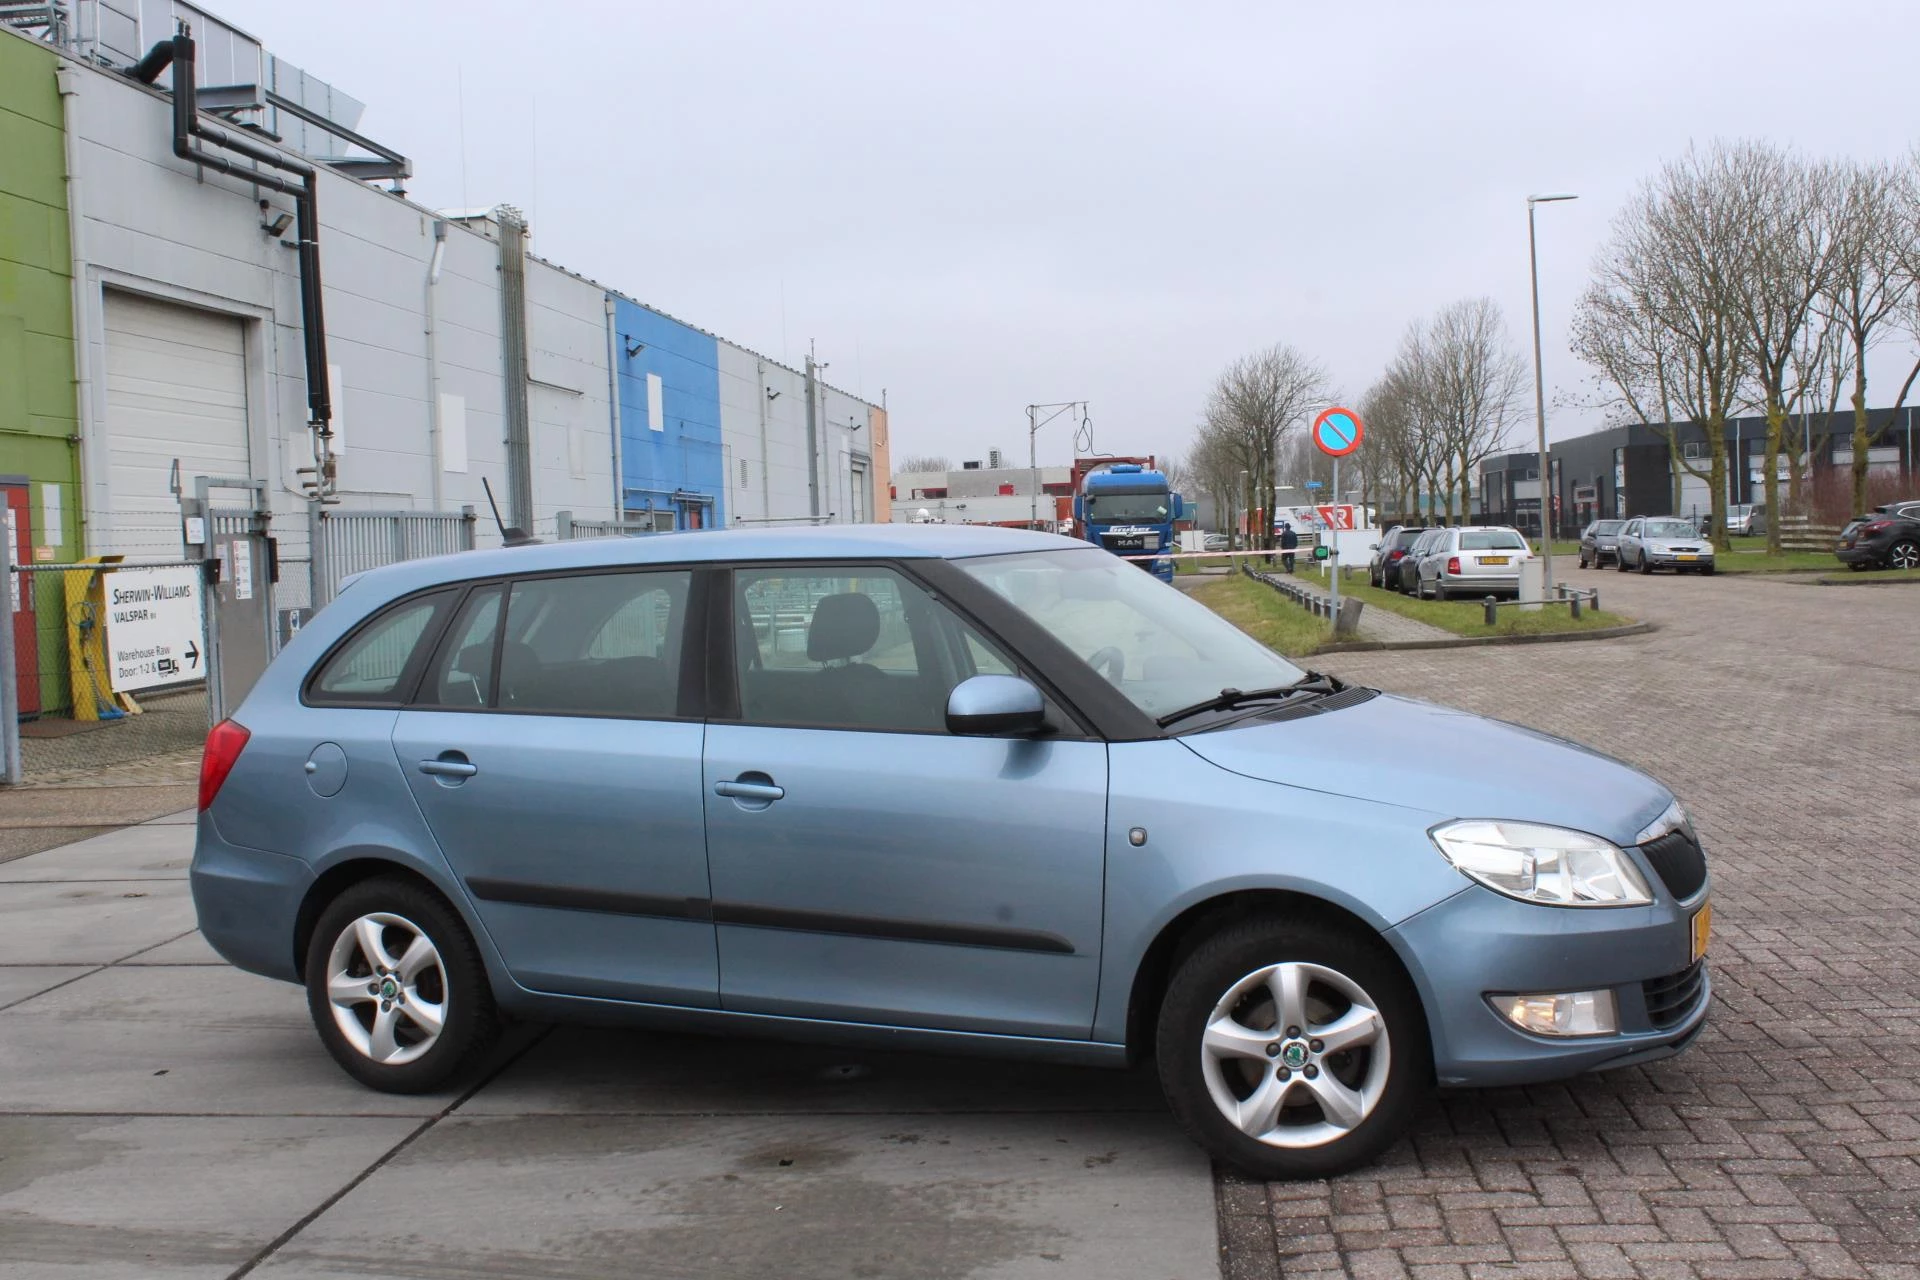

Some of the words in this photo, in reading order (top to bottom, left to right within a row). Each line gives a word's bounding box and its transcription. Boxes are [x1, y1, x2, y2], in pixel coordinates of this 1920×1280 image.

[1117, 539, 1142, 547] MAN
[113, 585, 191, 605] SHERWIN-WILLIAMS
[114, 609, 149, 623] VALSPAR
[117, 649, 155, 662] Warehouse
[156, 645, 171, 656] Raw
[119, 666, 137, 678] Door:
[139, 662, 150, 674] 1-2
[151, 662, 157, 673] &
